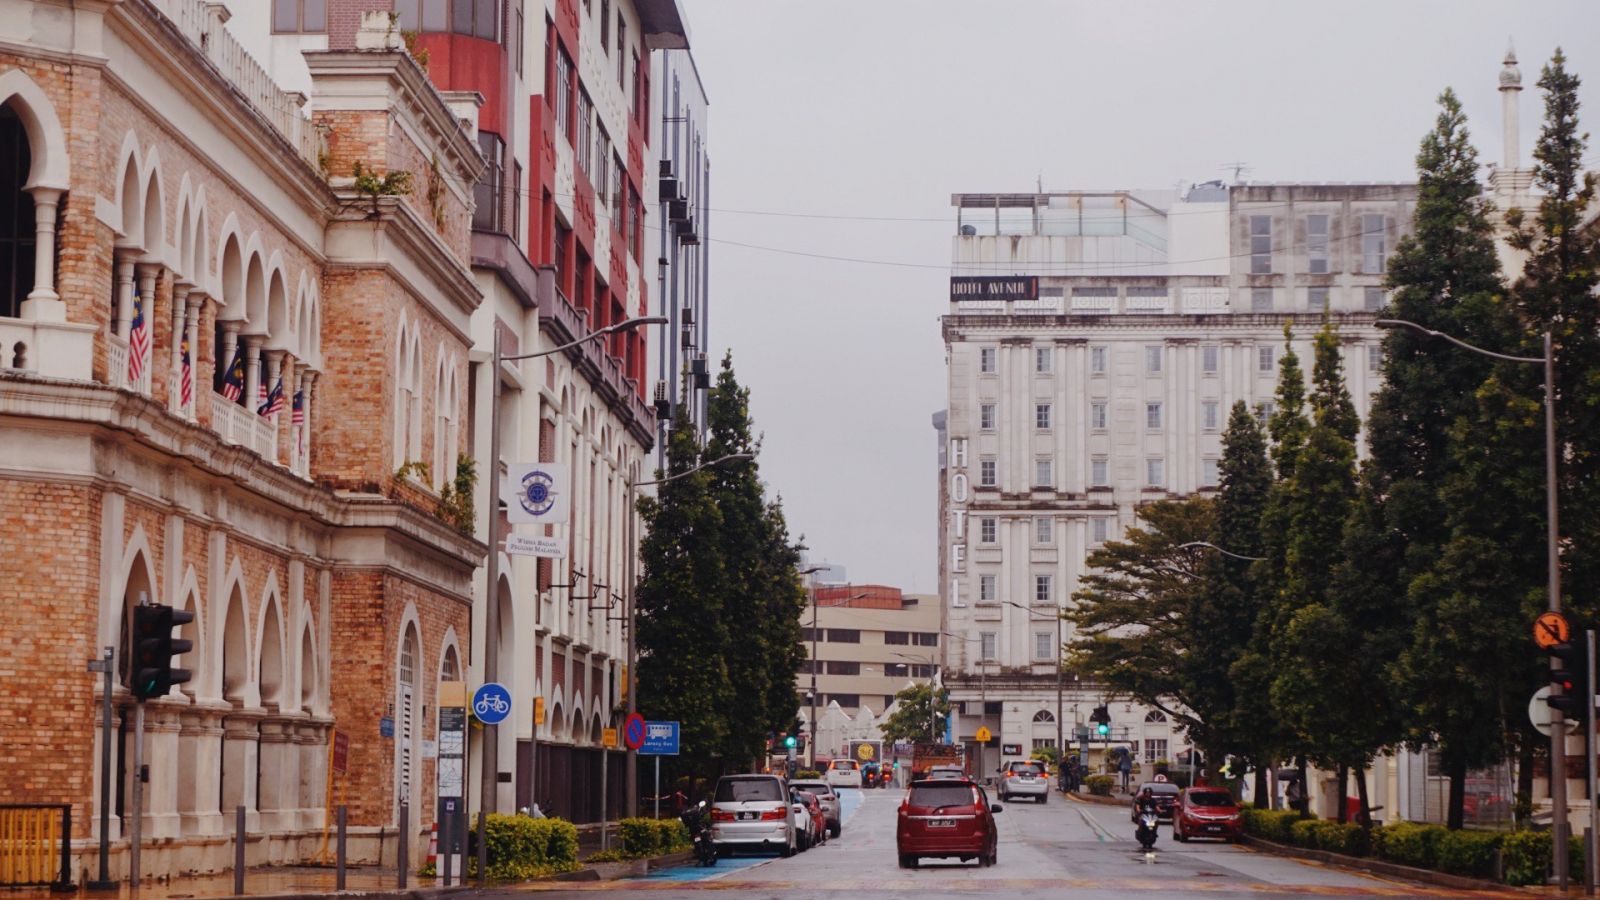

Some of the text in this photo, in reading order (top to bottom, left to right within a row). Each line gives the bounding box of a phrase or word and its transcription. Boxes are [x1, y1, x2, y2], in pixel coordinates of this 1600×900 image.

[952, 282, 1024, 294] HOTEL AVENUE
[951, 439, 968, 609] HOTEL
